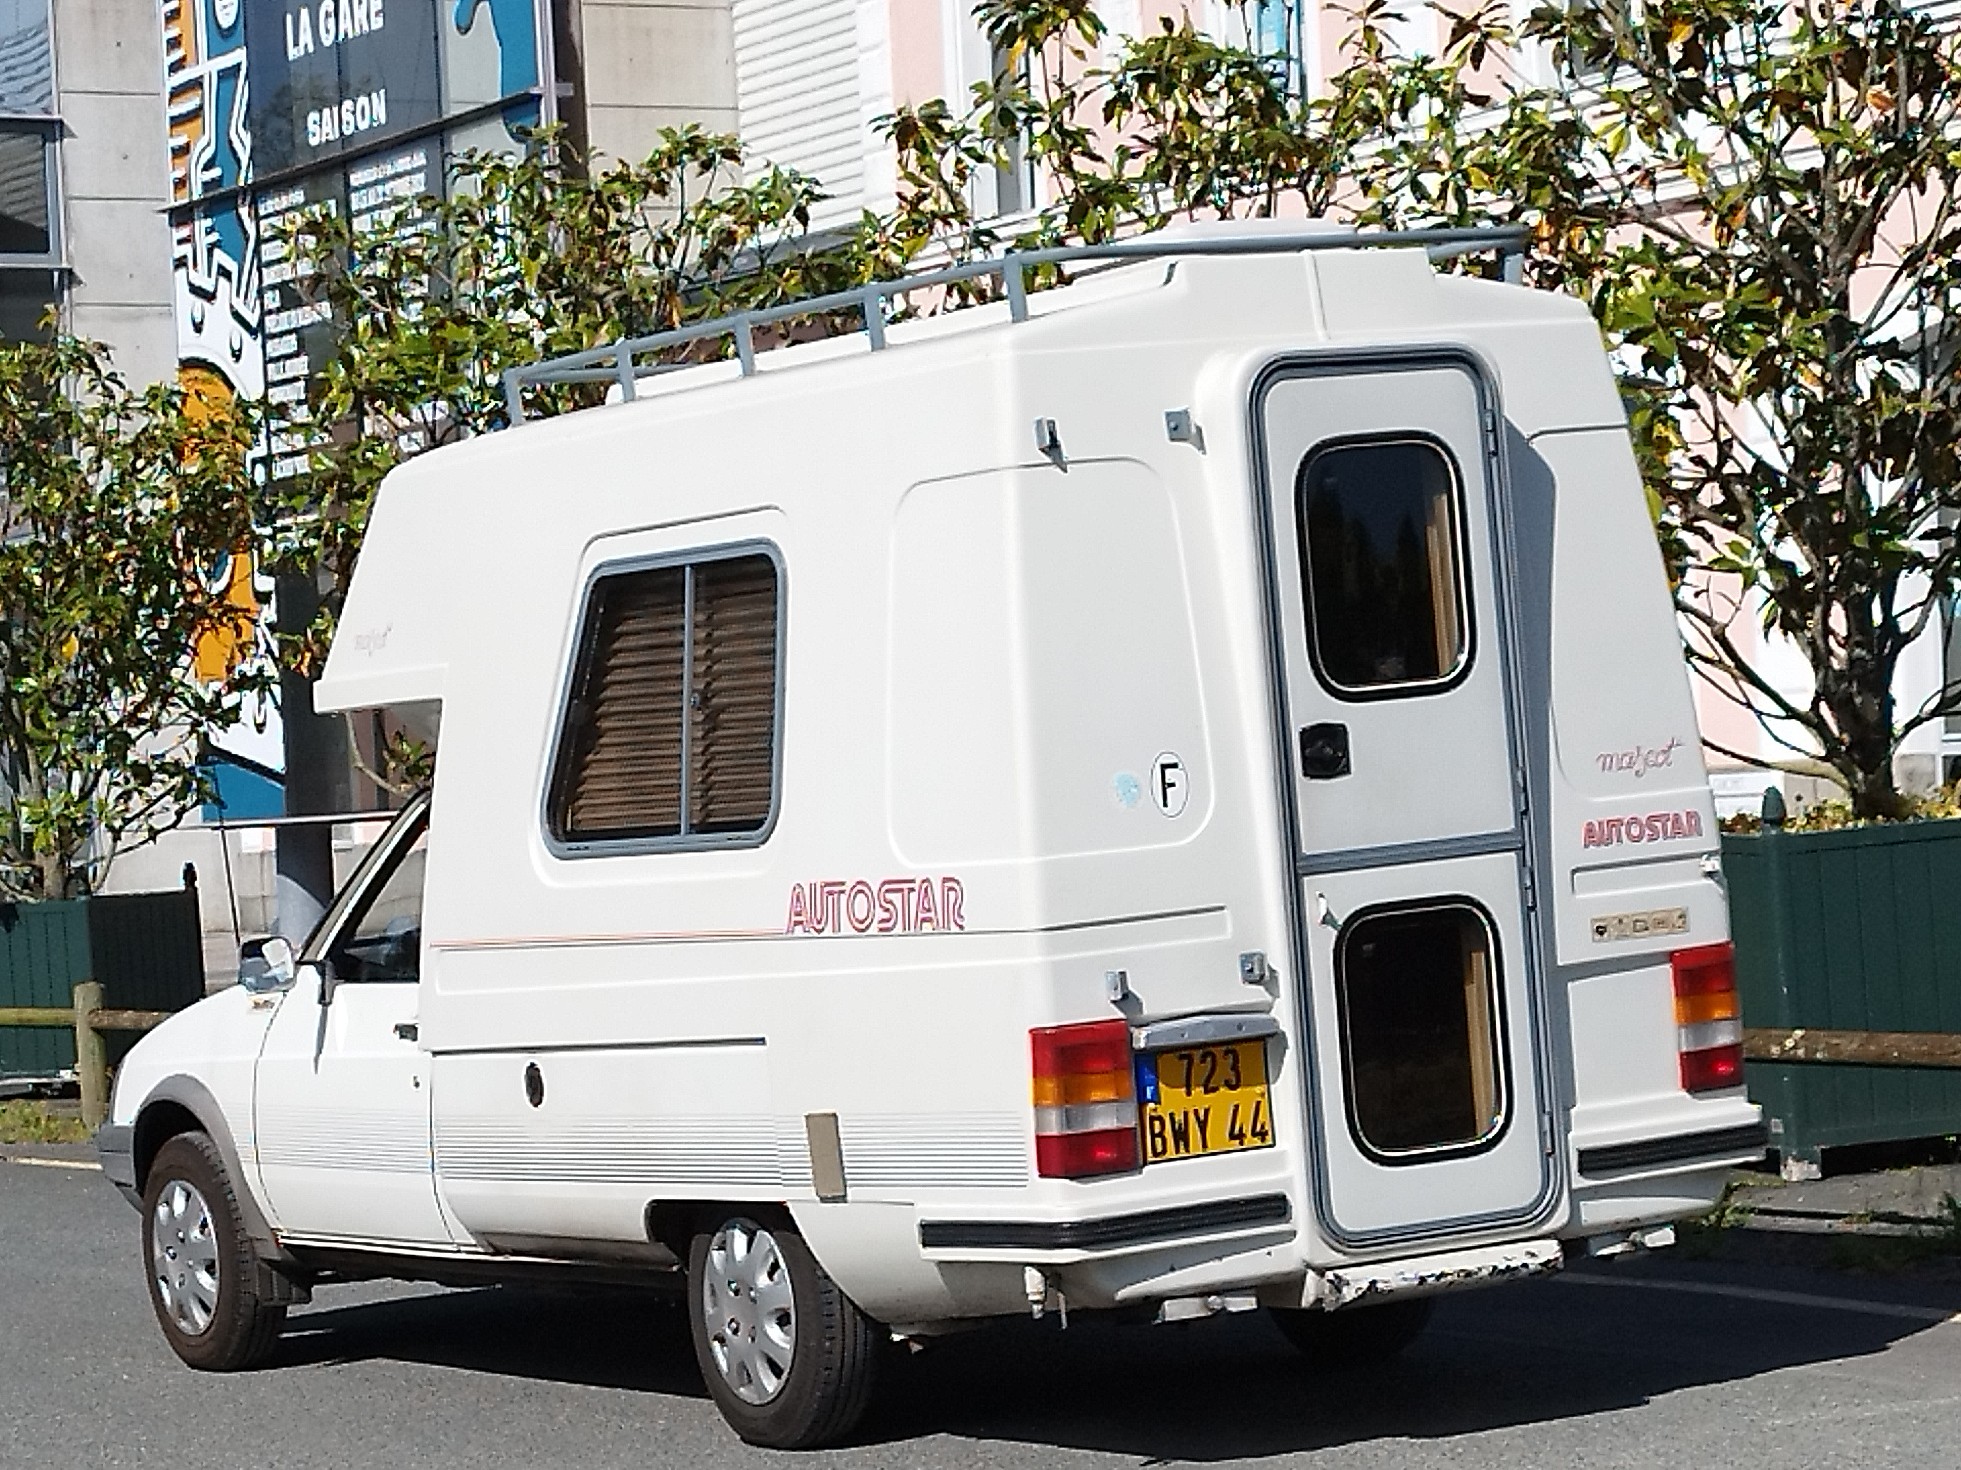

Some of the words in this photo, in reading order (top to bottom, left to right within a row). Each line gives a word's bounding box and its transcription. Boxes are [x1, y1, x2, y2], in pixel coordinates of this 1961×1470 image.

[286, 6, 314, 61] LA
[319, 0, 384, 47] GARE
[307, 89, 386, 147] SAISON
[1159, 761, 1179, 808] F
[1582, 809, 1704, 849] AUTOSTAR
[786, 876, 966, 935] AUTOSTAR
[1178, 1047, 1242, 1097] 723
[1148, 1106, 1211, 1158] BWY
[1228, 1100, 1269, 1147] 44
